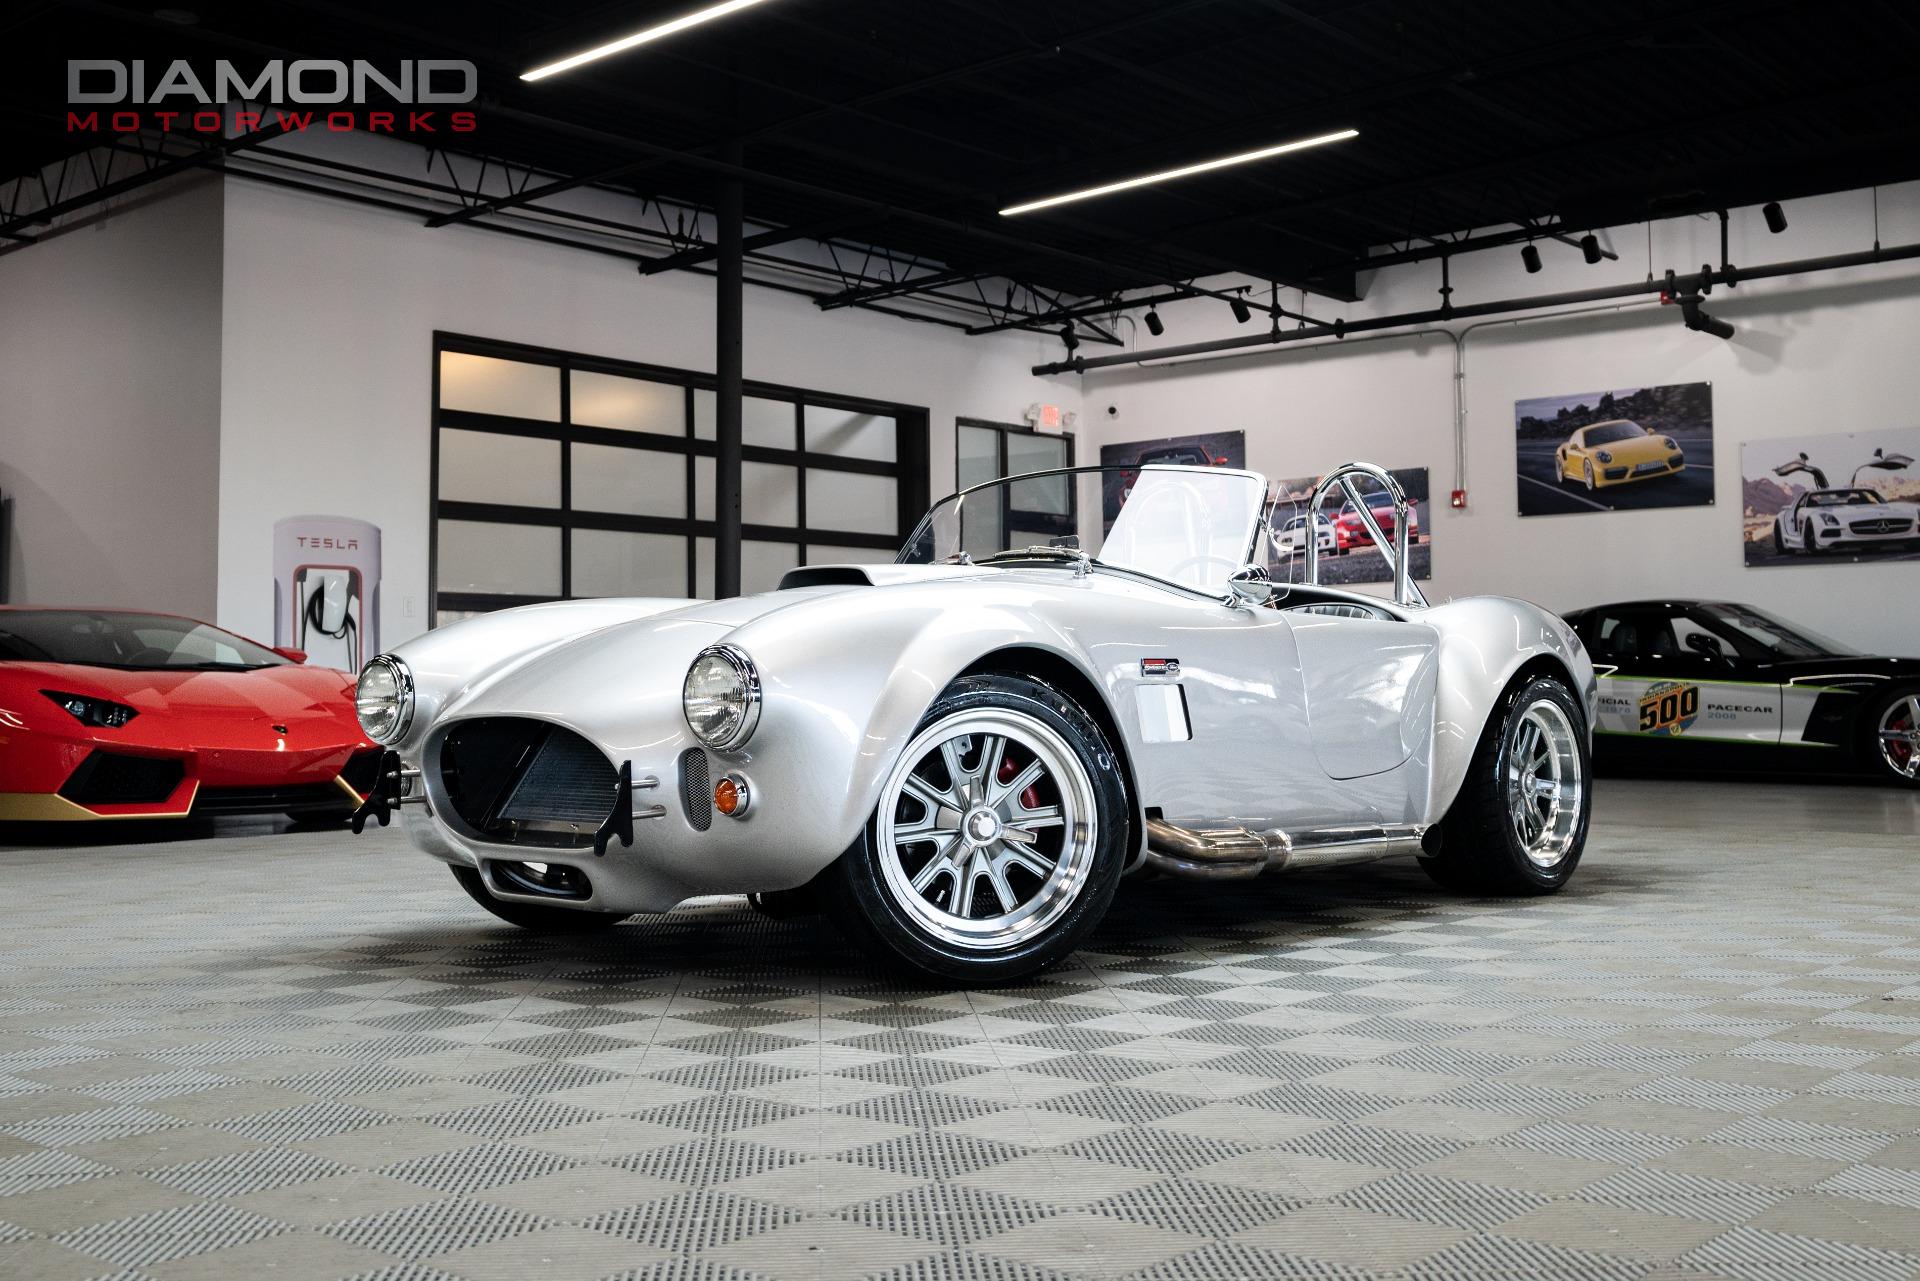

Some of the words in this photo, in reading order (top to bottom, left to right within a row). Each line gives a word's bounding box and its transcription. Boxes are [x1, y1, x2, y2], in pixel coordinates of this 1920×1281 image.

[297, 537, 358, 551] TESLA
[1639, 686, 1699, 731] 500
[1707, 703, 1773, 714] PACECAR
